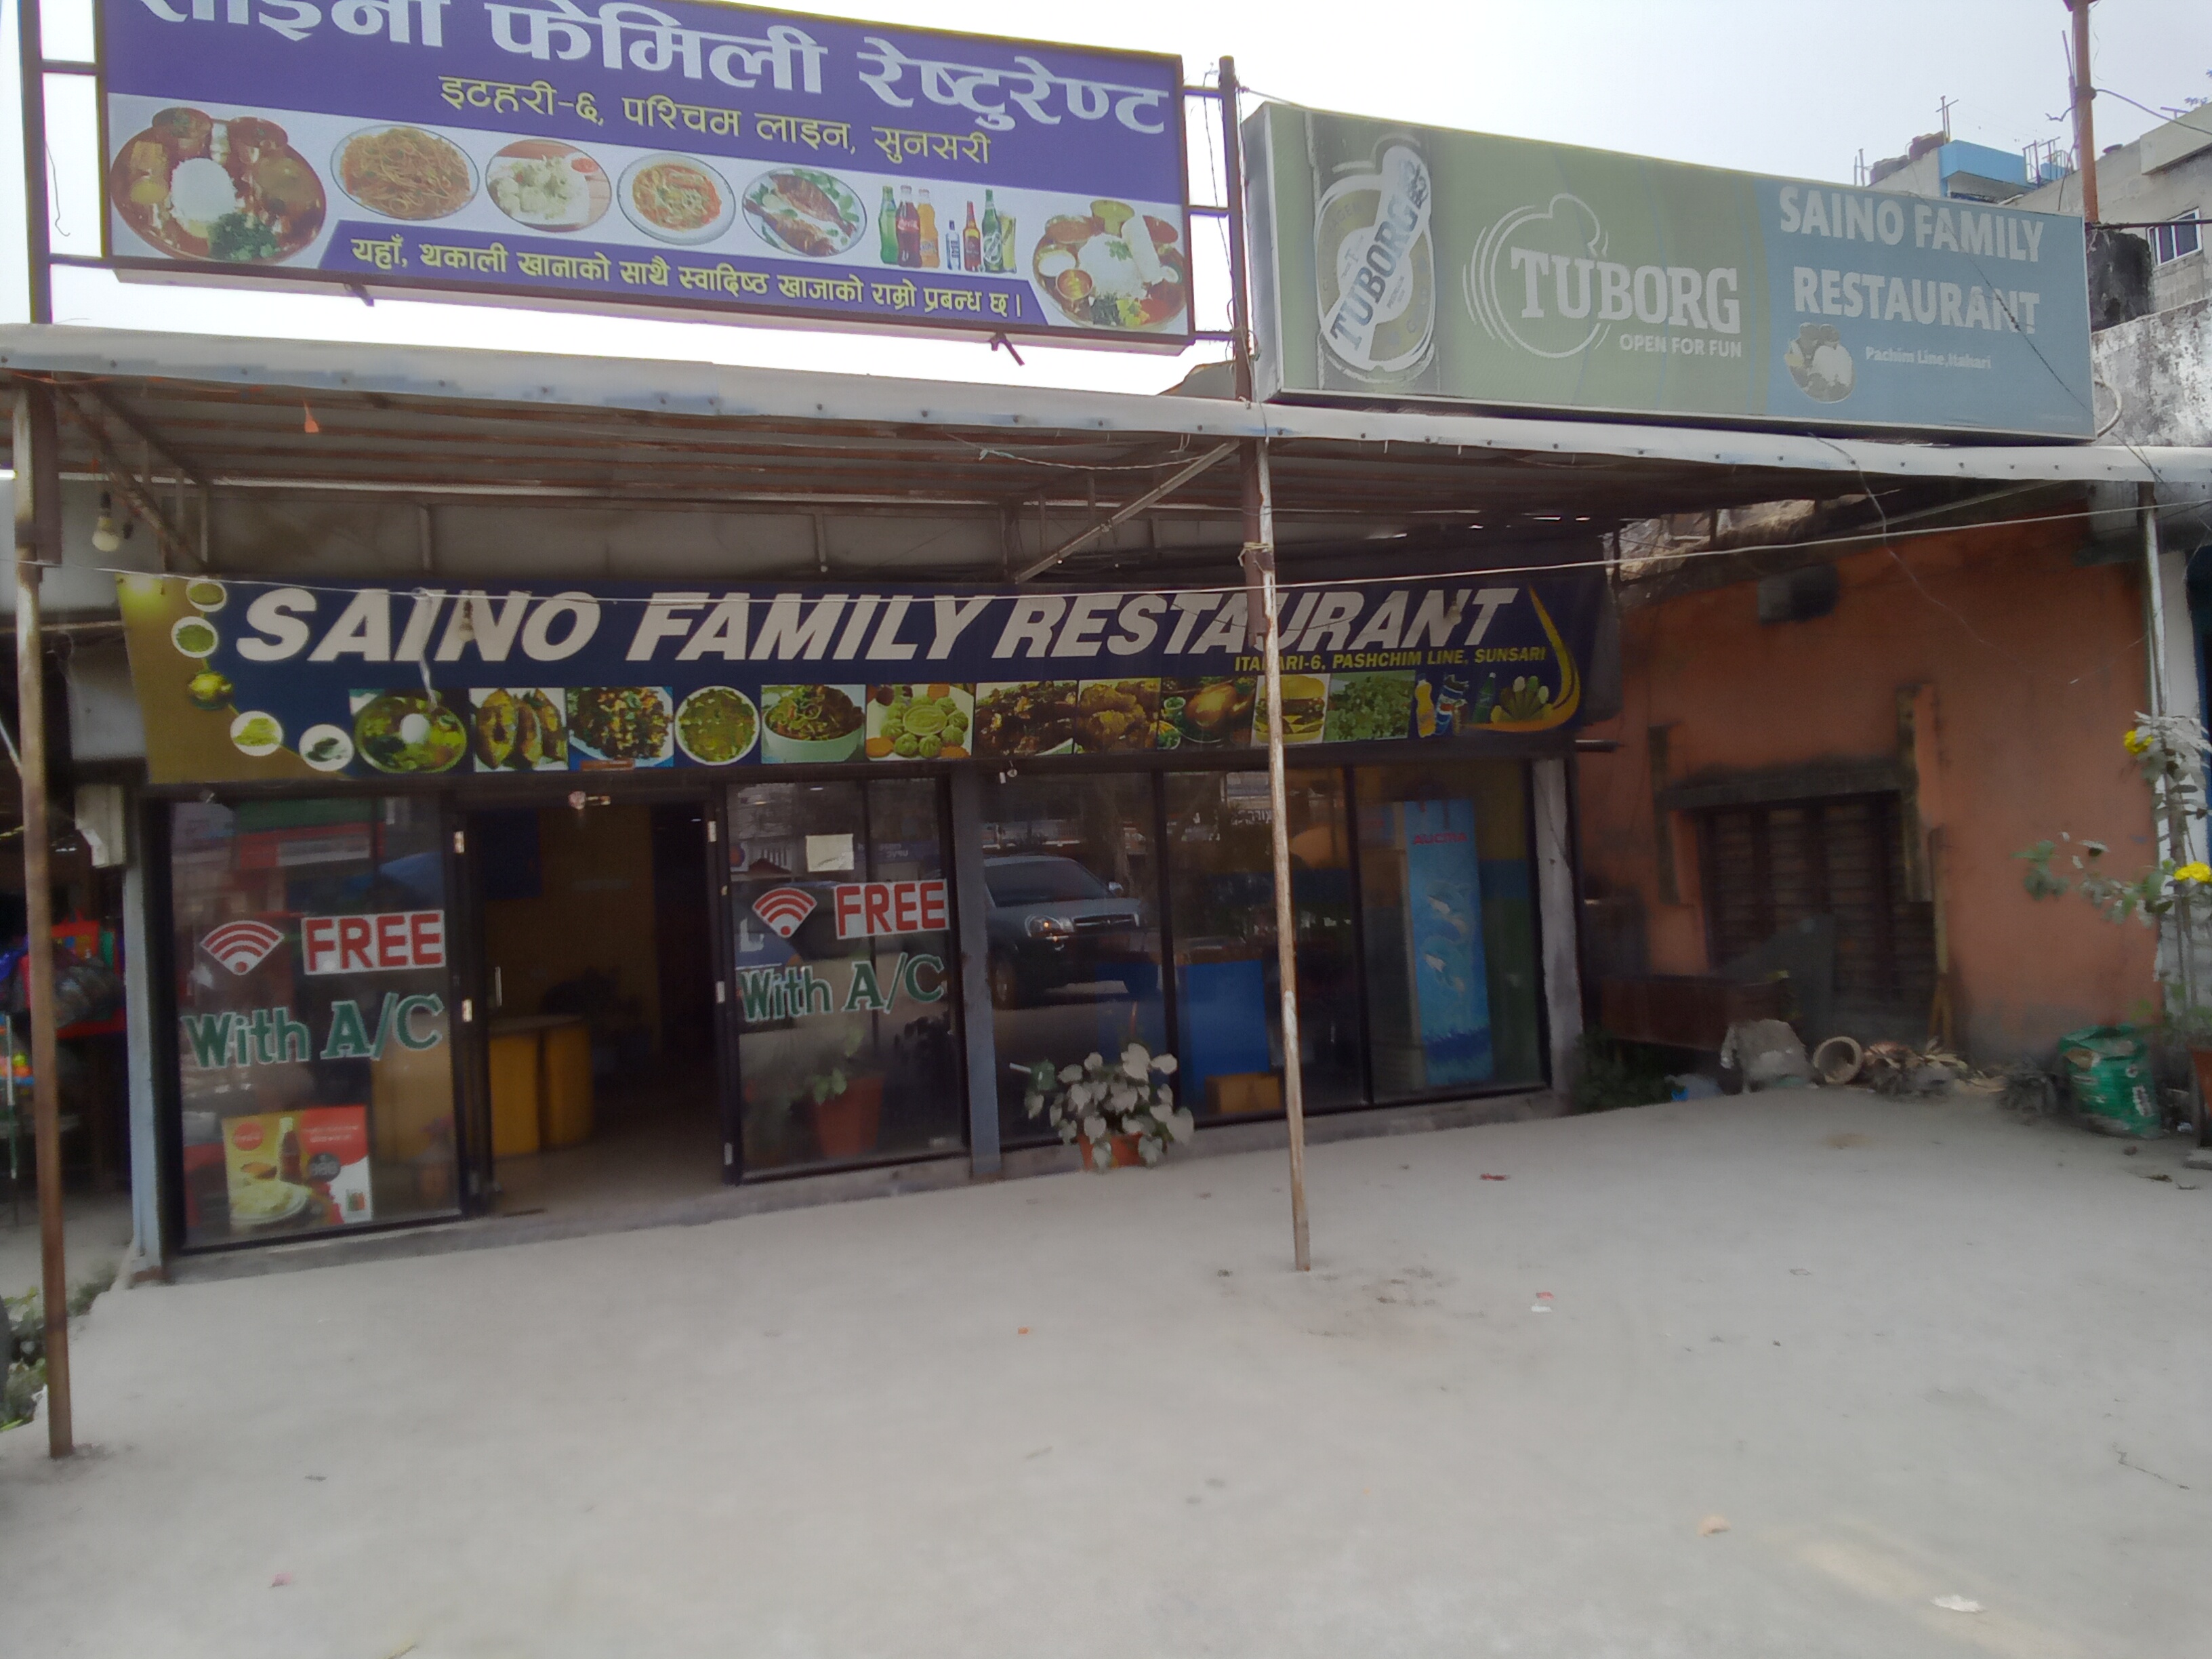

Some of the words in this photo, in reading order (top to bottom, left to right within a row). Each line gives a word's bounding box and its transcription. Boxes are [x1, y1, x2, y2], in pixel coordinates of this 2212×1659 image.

[621, 94, 742, 137] पश्चिम
[754, 112, 856, 155] लाइन,
[871, 125, 991, 164] सुनसरी
[1780, 185, 1904, 246] SAINO
[1915, 203, 2044, 263] FAMILY
[418, 242, 508, 273] थकाली
[516, 251, 611, 282] खानाको
[619, 255, 672, 287] साथै
[777, 274, 864, 303] खाजाको
[872, 278, 917, 311] राम्रो
[924, 286, 983, 313] प्रबन्ध
[1330, 194, 1418, 352] TUBORG
[1511, 246, 1741, 334] TUBORG
[1793, 265, 2041, 335] RESTAURANT
[1620, 333, 1667, 353] OPEN
[1671, 337, 1705, 355] FOR
[1709, 340, 1742, 358] FUN
[236, 588, 601, 661] SAINO
[625, 592, 992, 661] FAMILY
[991, 587, 1519, 659] RESTAURANT
[1332, 651, 1422, 670] PASHCHIM
[1427, 649, 1468, 667] LINE,
[1475, 646, 1546, 664] SUNSARI
[306, 913, 443, 972] FREE
[836, 882, 946, 937] FREE
[739, 966, 834, 1023] With
[841, 952, 946, 1014] A/C
[182, 1006, 311, 1069] With
[321, 991, 445, 1061] A/C
